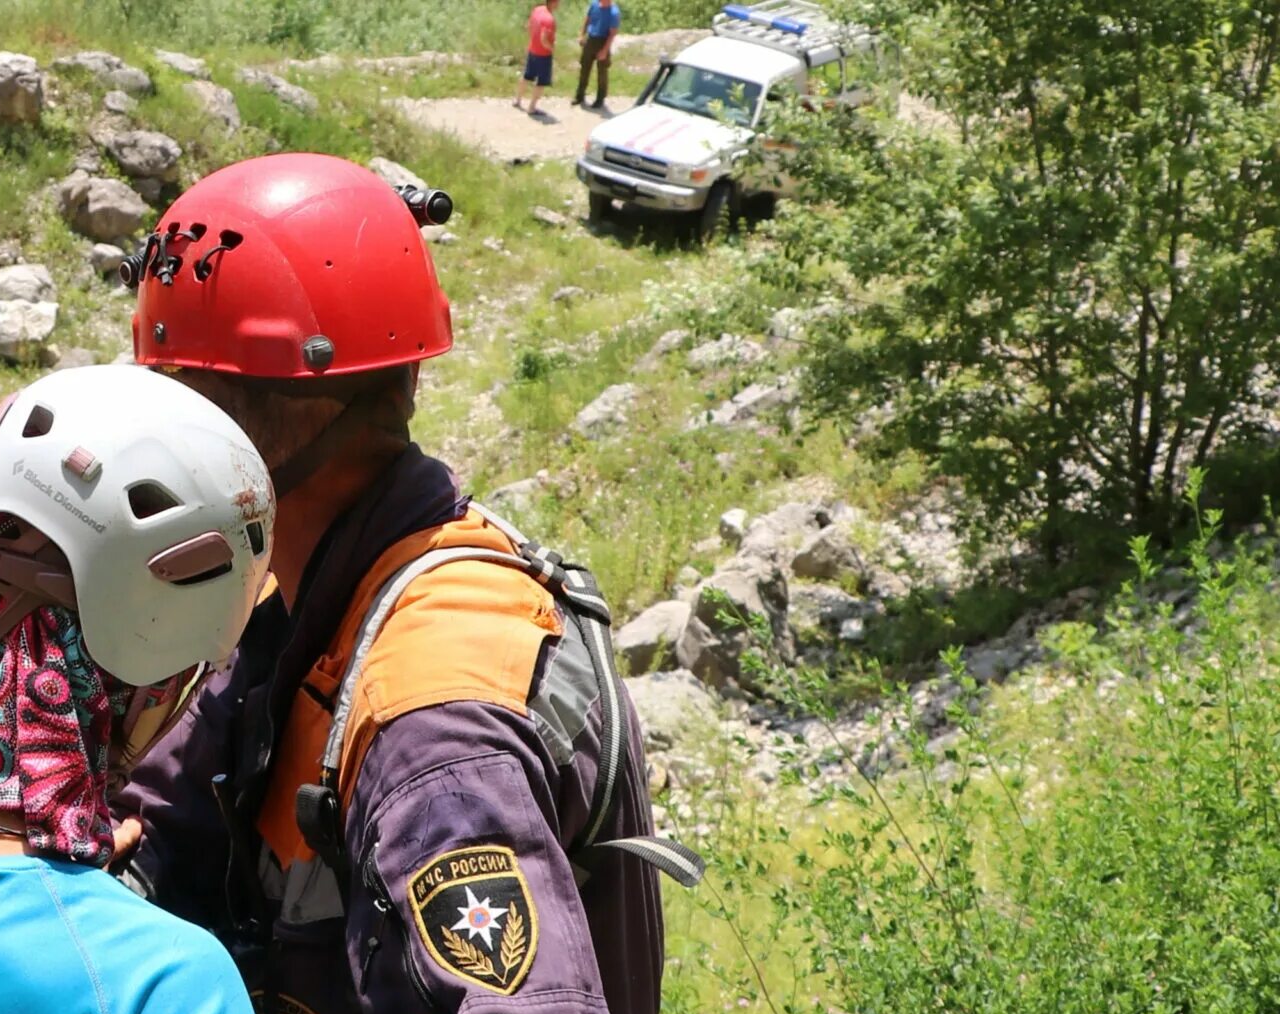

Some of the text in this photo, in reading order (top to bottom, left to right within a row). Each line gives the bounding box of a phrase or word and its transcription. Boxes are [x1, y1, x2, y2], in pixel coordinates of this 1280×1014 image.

[23, 469, 108, 534] Black Diamond
[416, 854, 508, 899] МЧС РОССИИ
